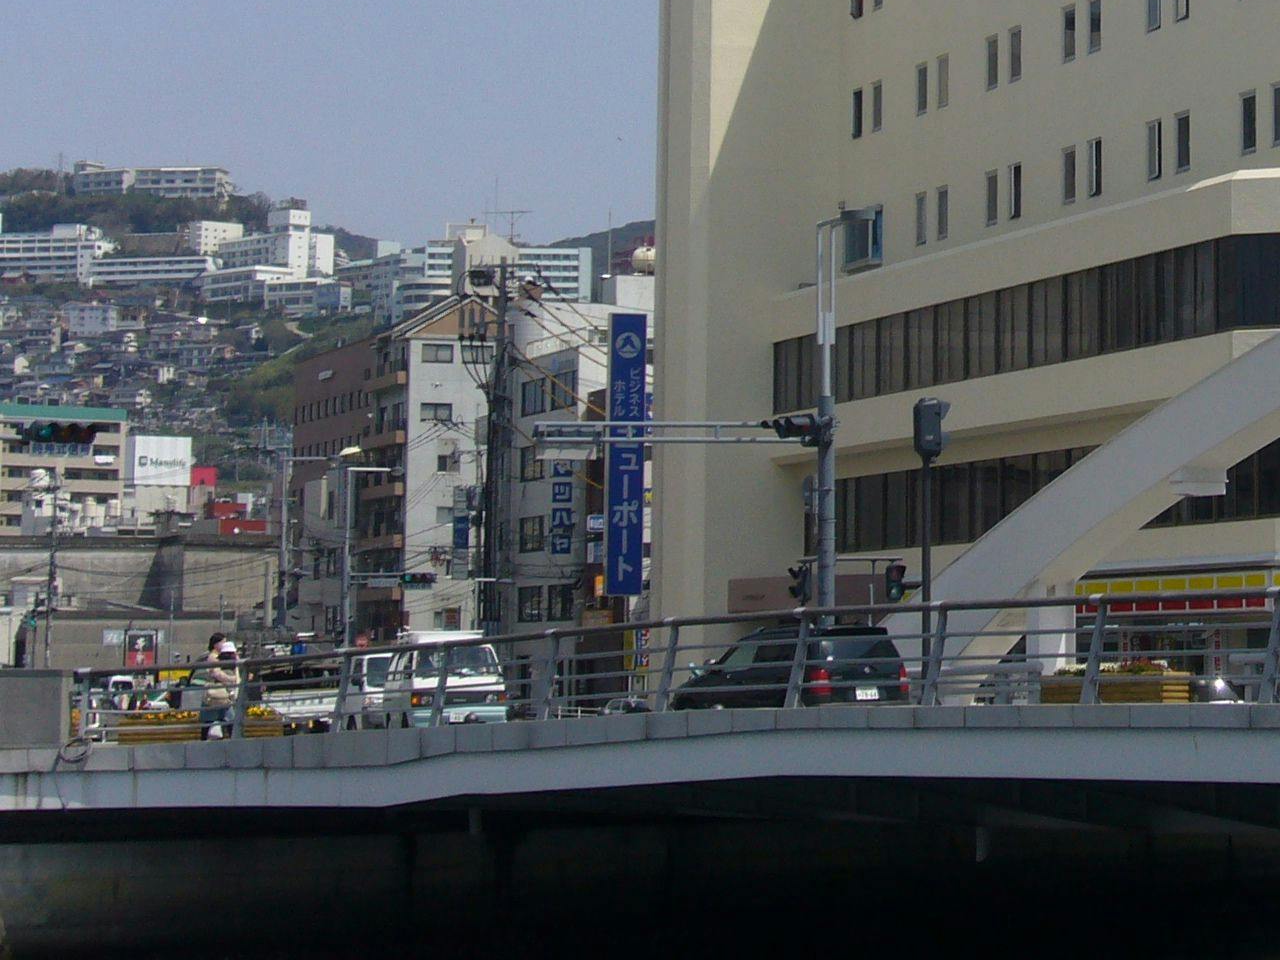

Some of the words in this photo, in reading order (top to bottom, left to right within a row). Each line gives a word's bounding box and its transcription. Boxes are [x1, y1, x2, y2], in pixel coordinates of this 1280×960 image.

[614, 381, 625, 417] ホテル
[629, 367, 641, 417] ビジネス
[612, 428, 640, 582] ニューポート
